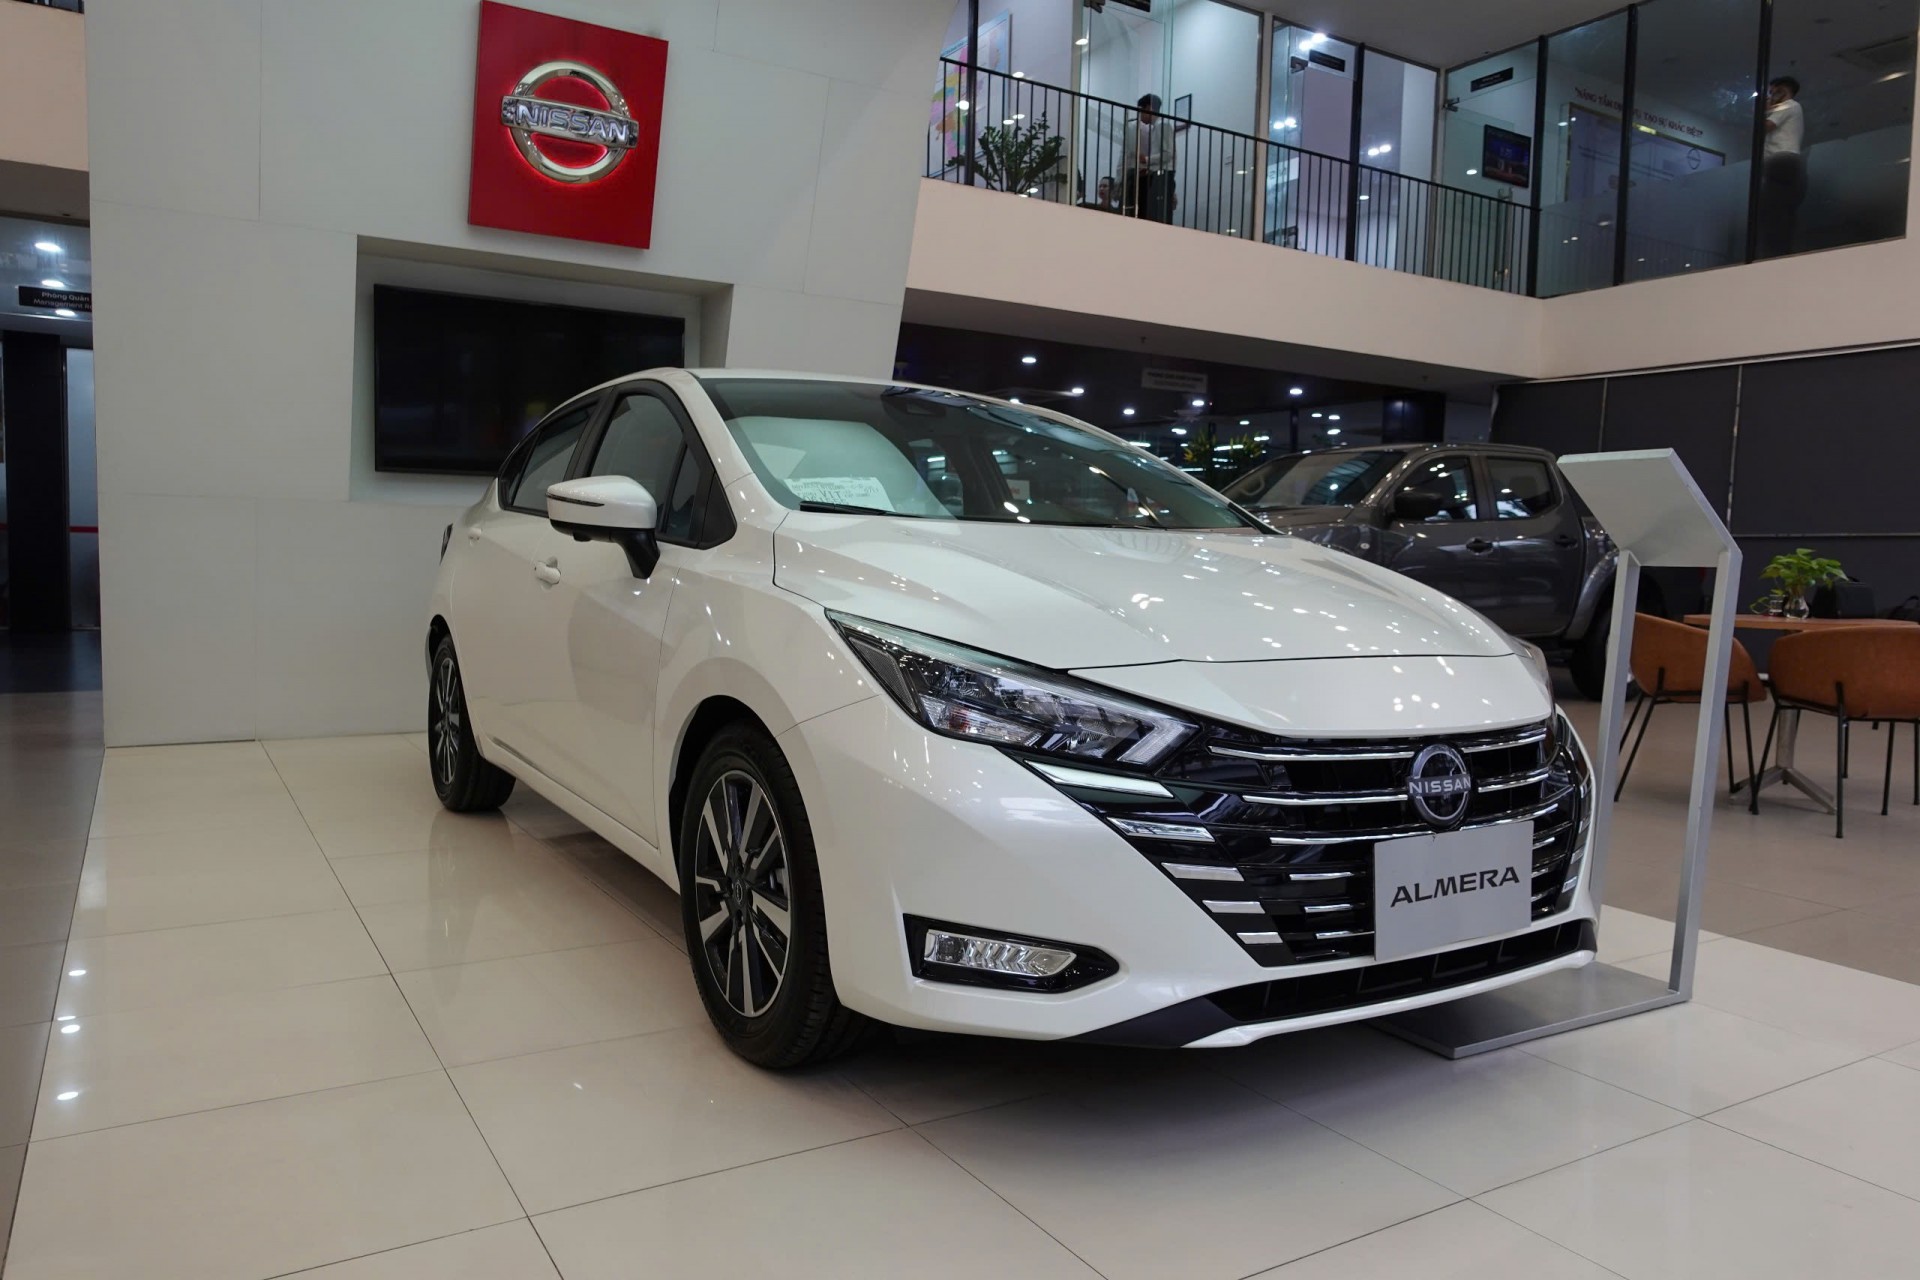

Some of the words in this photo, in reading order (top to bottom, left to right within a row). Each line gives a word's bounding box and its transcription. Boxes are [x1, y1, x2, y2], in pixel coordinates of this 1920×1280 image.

[516, 103, 629, 141] NISSAN
[33, 299, 83, 309] Management
[1408, 777, 1471, 794] NISSAN
[1389, 866, 1521, 908] ALMERA
